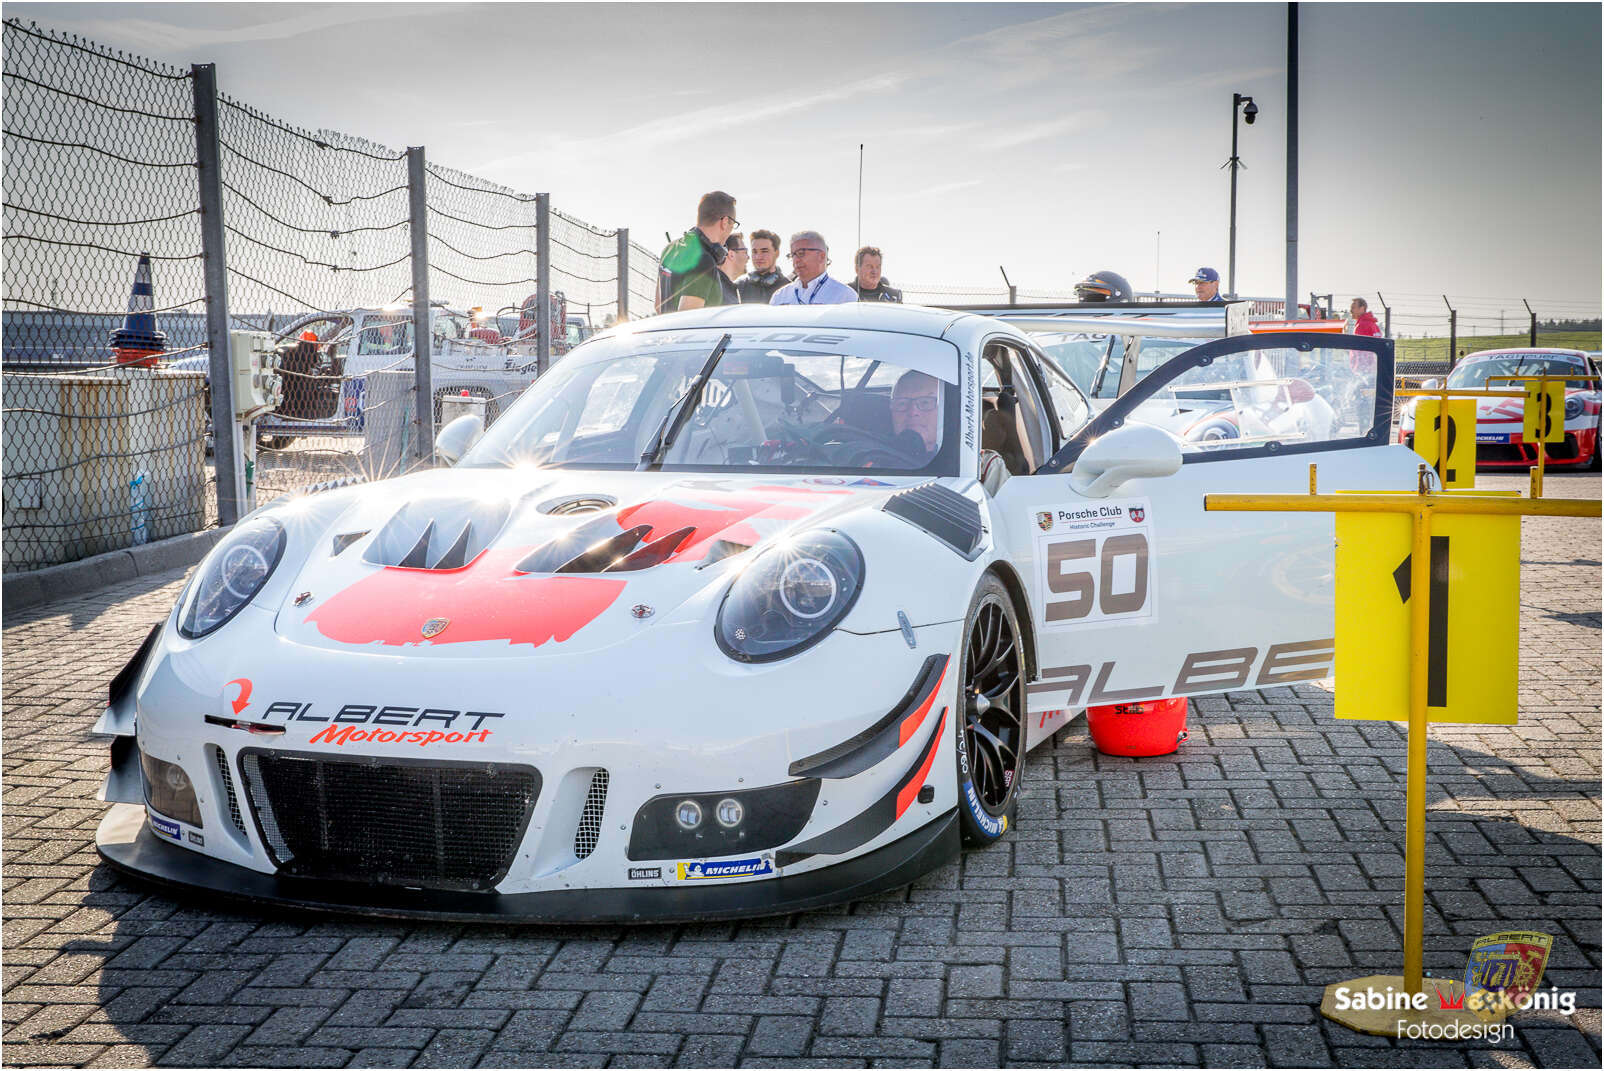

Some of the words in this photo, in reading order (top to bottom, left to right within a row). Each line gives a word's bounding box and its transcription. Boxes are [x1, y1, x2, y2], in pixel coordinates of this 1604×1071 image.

[1535, 391, 1553, 439] 3
[1433, 414, 1457, 482] 2
[1058, 508, 1098, 521] Porsche
[1099, 505, 1122, 517] Club
[1045, 533, 1149, 622] 50
[1392, 535, 1450, 708] 1
[262, 701, 505, 731] ALBERT
[308, 724, 495, 747] Motorsport
[967, 786, 999, 834] MICHELIN
[705, 862, 767, 876] MICHELIN
